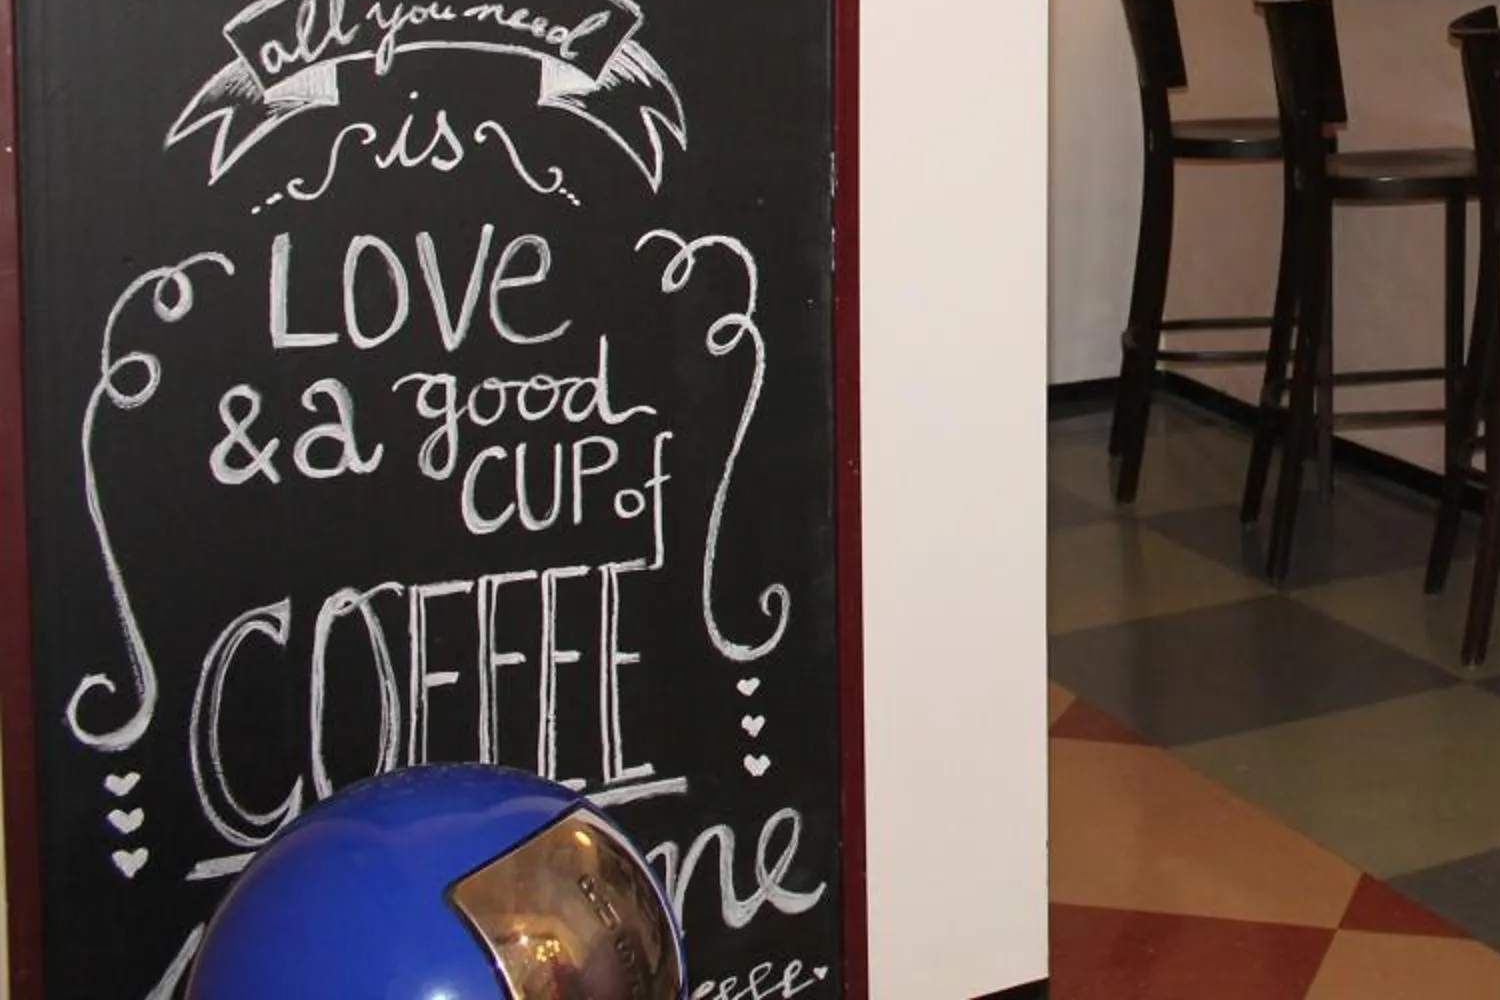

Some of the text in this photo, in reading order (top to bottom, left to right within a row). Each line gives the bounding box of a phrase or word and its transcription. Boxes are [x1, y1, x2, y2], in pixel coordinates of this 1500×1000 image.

[365, 1, 457, 76] you
[464, 1, 612, 60] need
[375, 90, 464, 171] is
[390, 334, 658, 481] good
[461, 431, 674, 570] CUP of
